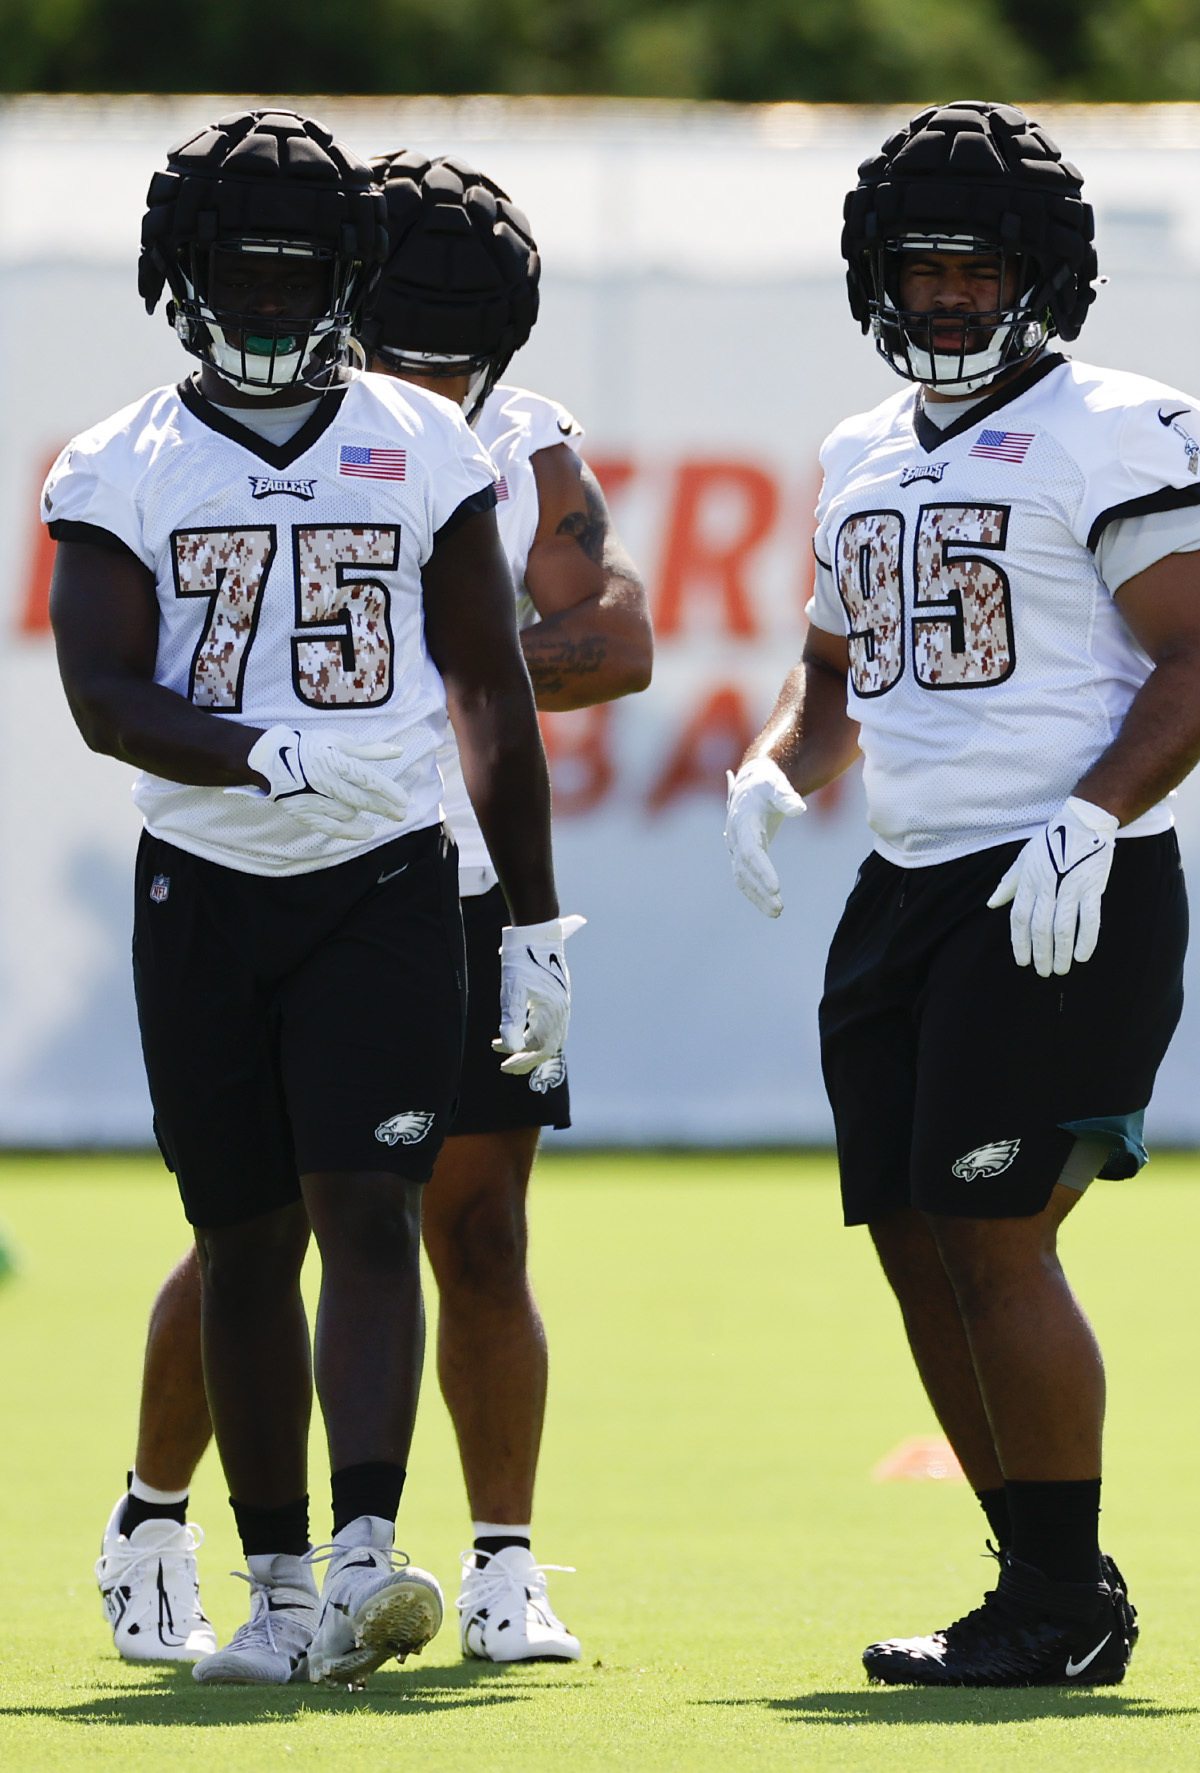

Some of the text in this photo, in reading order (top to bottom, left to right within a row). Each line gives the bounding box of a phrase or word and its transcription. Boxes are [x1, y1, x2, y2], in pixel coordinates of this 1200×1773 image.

[899, 462, 950, 488] EAGLES
[248, 476, 318, 501] EAGLES
[836, 502, 1016, 699] 95
[170, 523, 400, 714] 75
[152, 886, 167, 898] NFL
